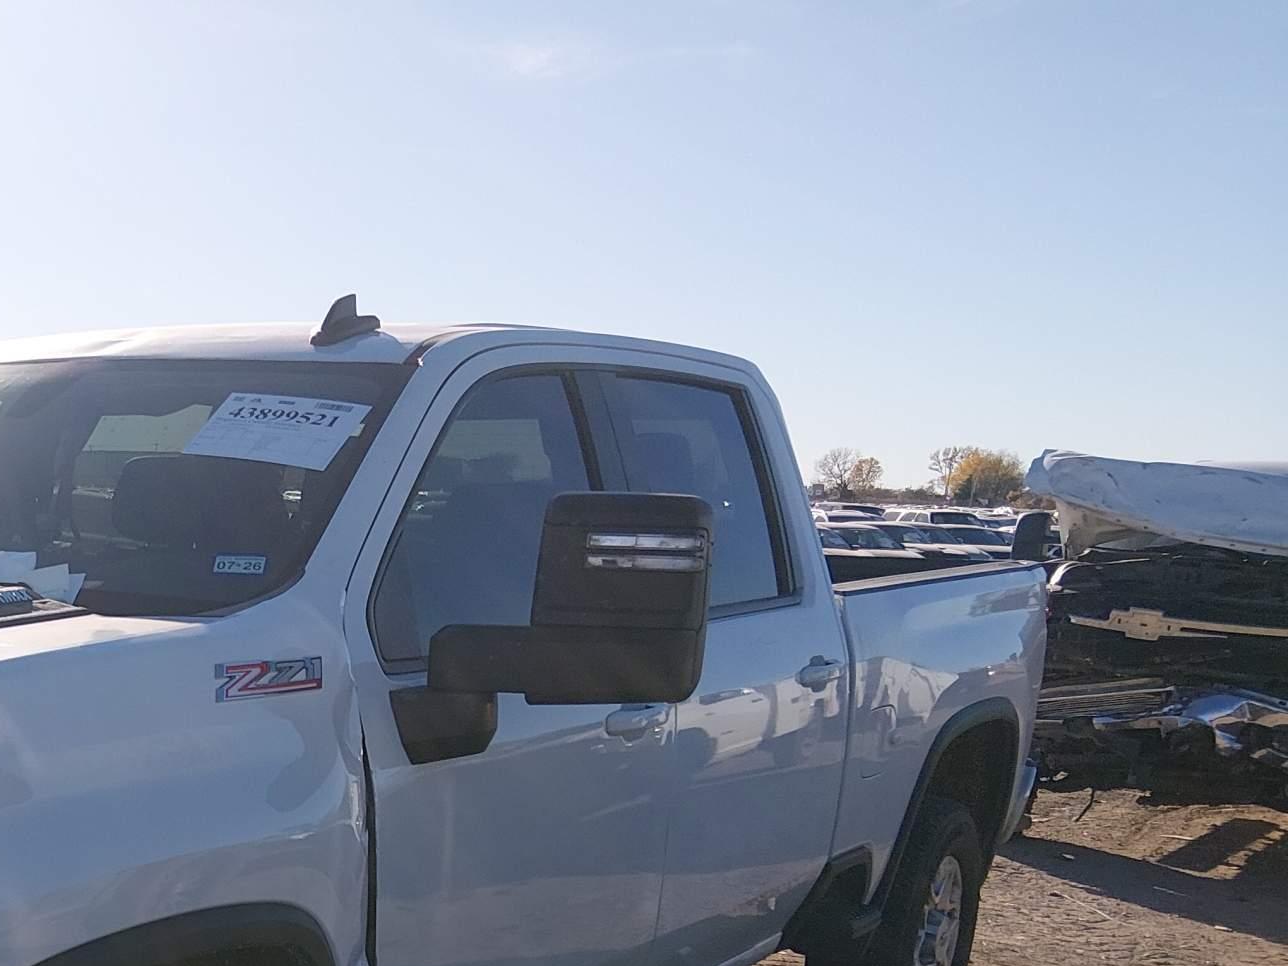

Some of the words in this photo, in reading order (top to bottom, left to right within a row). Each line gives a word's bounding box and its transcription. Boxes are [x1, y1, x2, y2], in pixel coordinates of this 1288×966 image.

[229, 406, 340, 428] 43899521
[215, 560, 263, 572] 07-26
[214, 656, 323, 704] Z71
